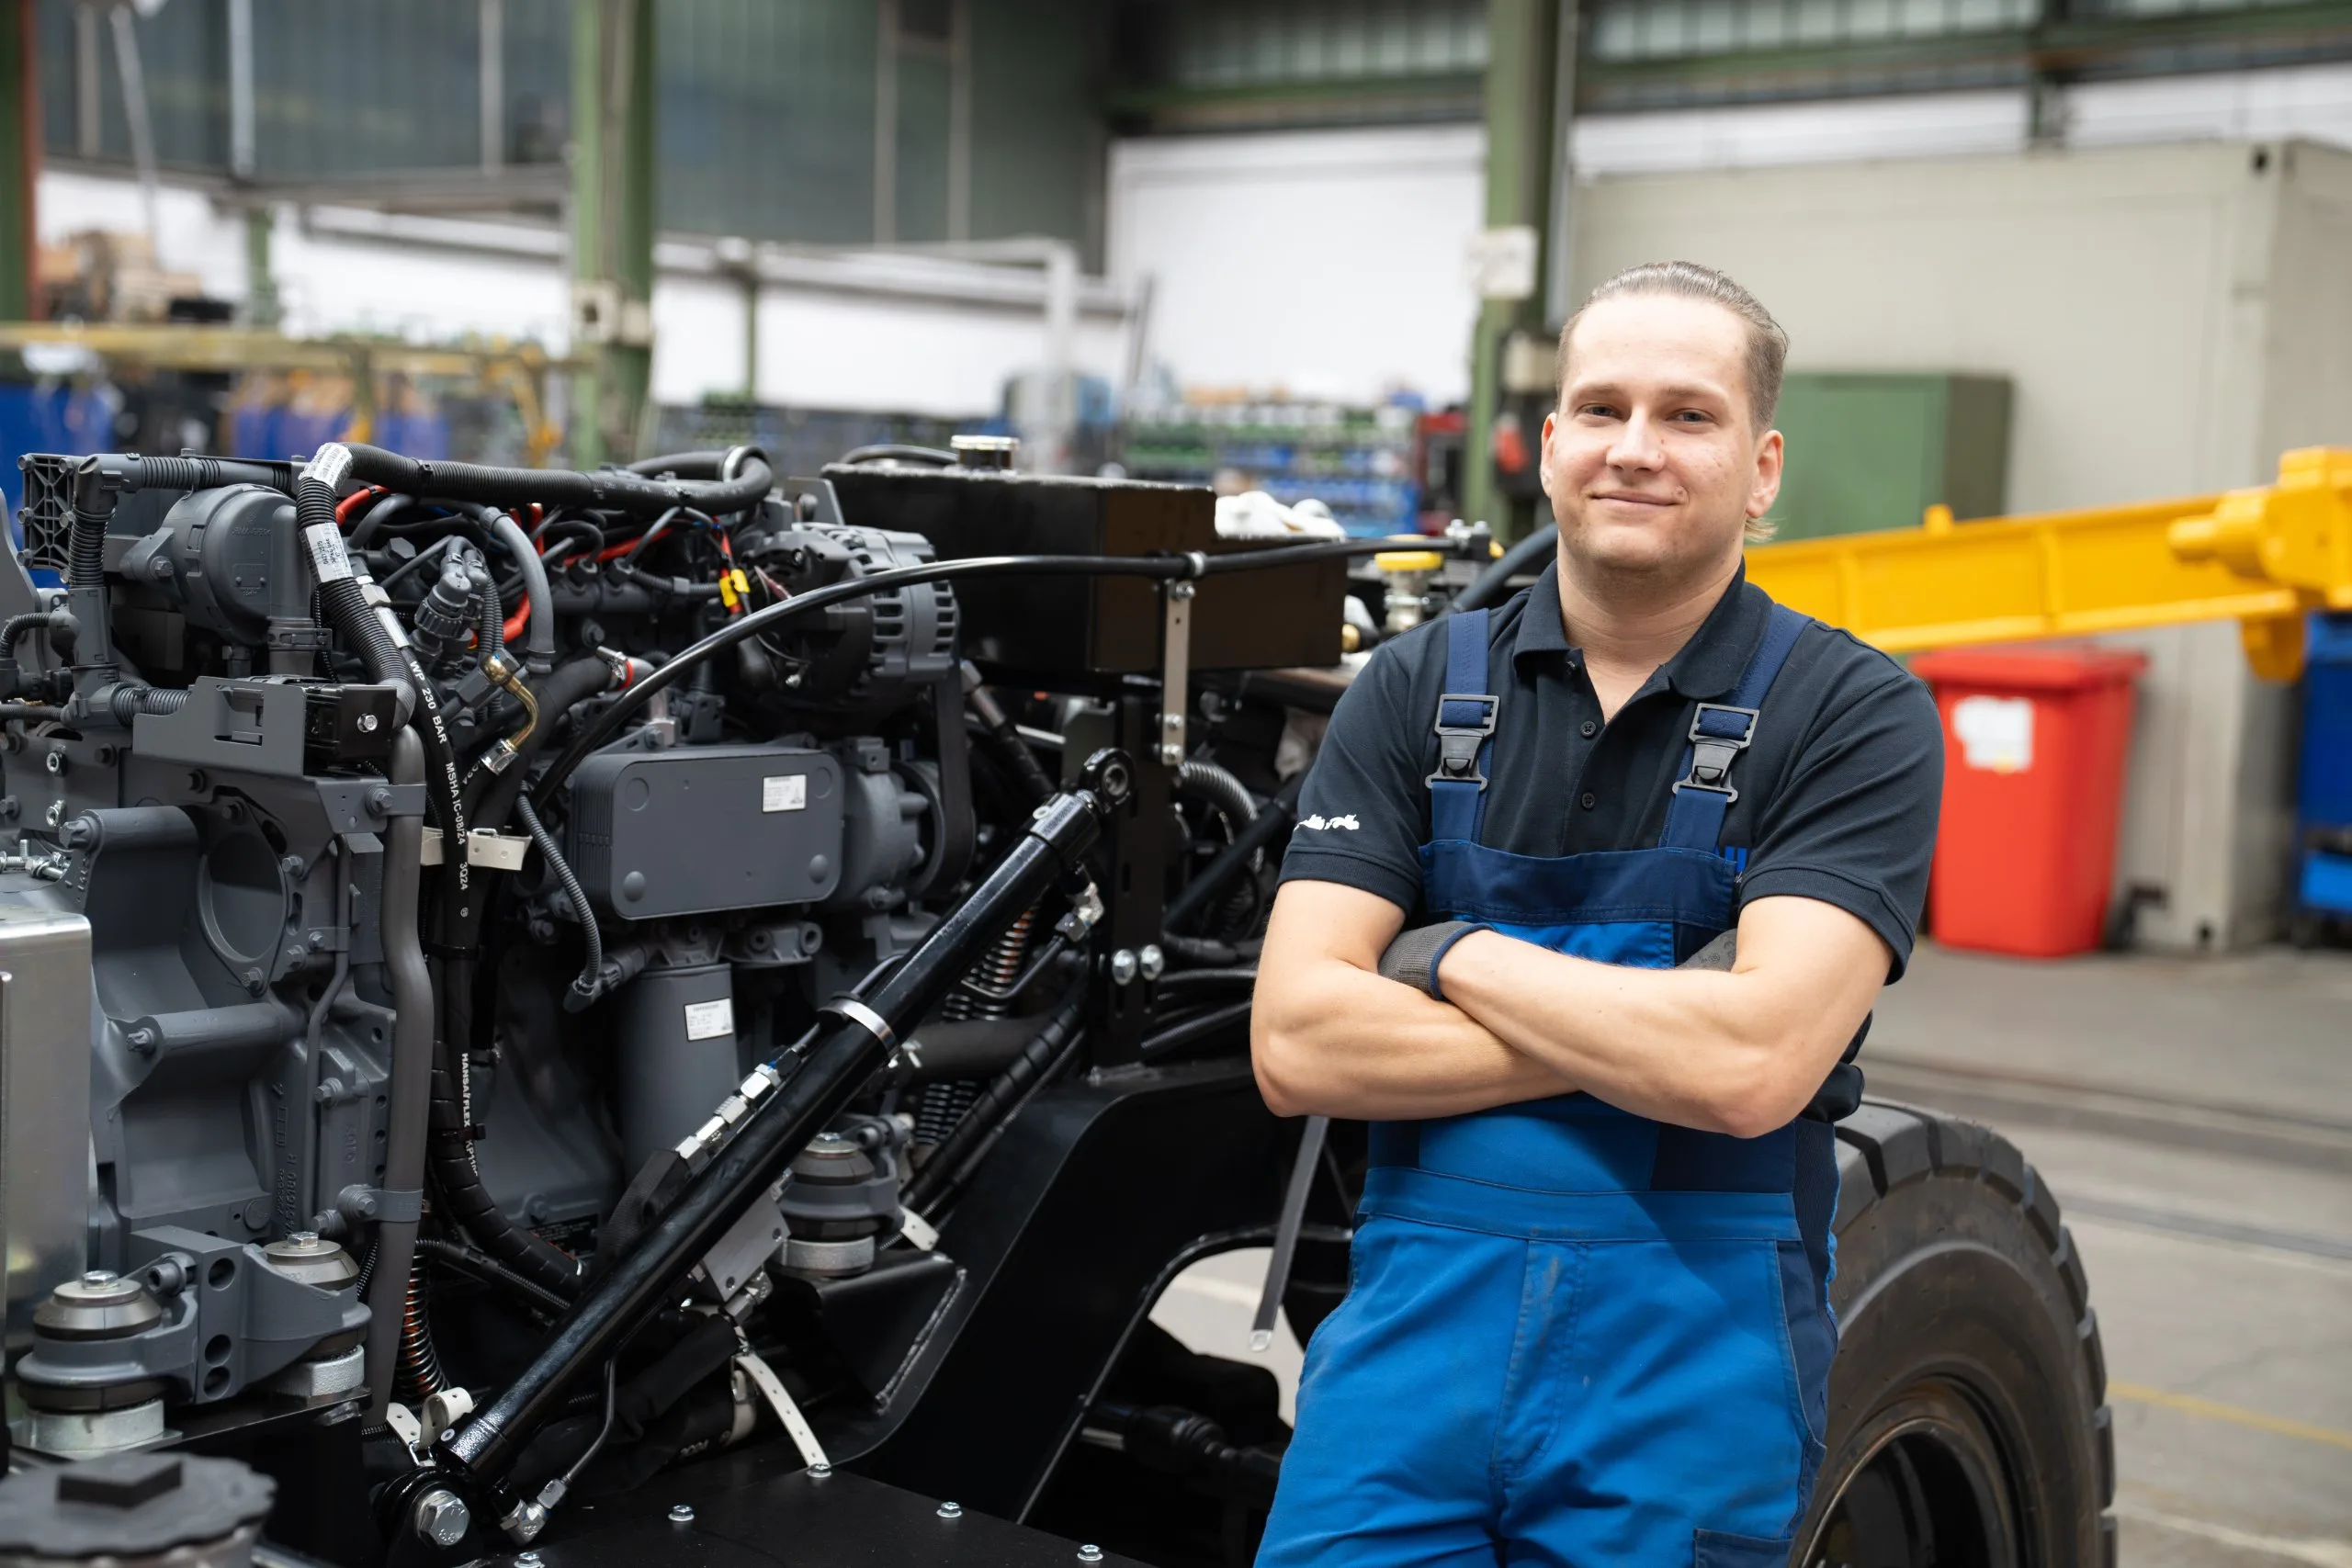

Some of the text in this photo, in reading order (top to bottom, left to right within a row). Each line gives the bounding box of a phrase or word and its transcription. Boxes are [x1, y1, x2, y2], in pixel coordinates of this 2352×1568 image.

[410, 660, 426, 681] WP
[422, 687, 436, 710] 230
[432, 715, 447, 744] BAR
[446, 761, 459, 798] MSHA
[459, 862, 469, 890] 3Q24
